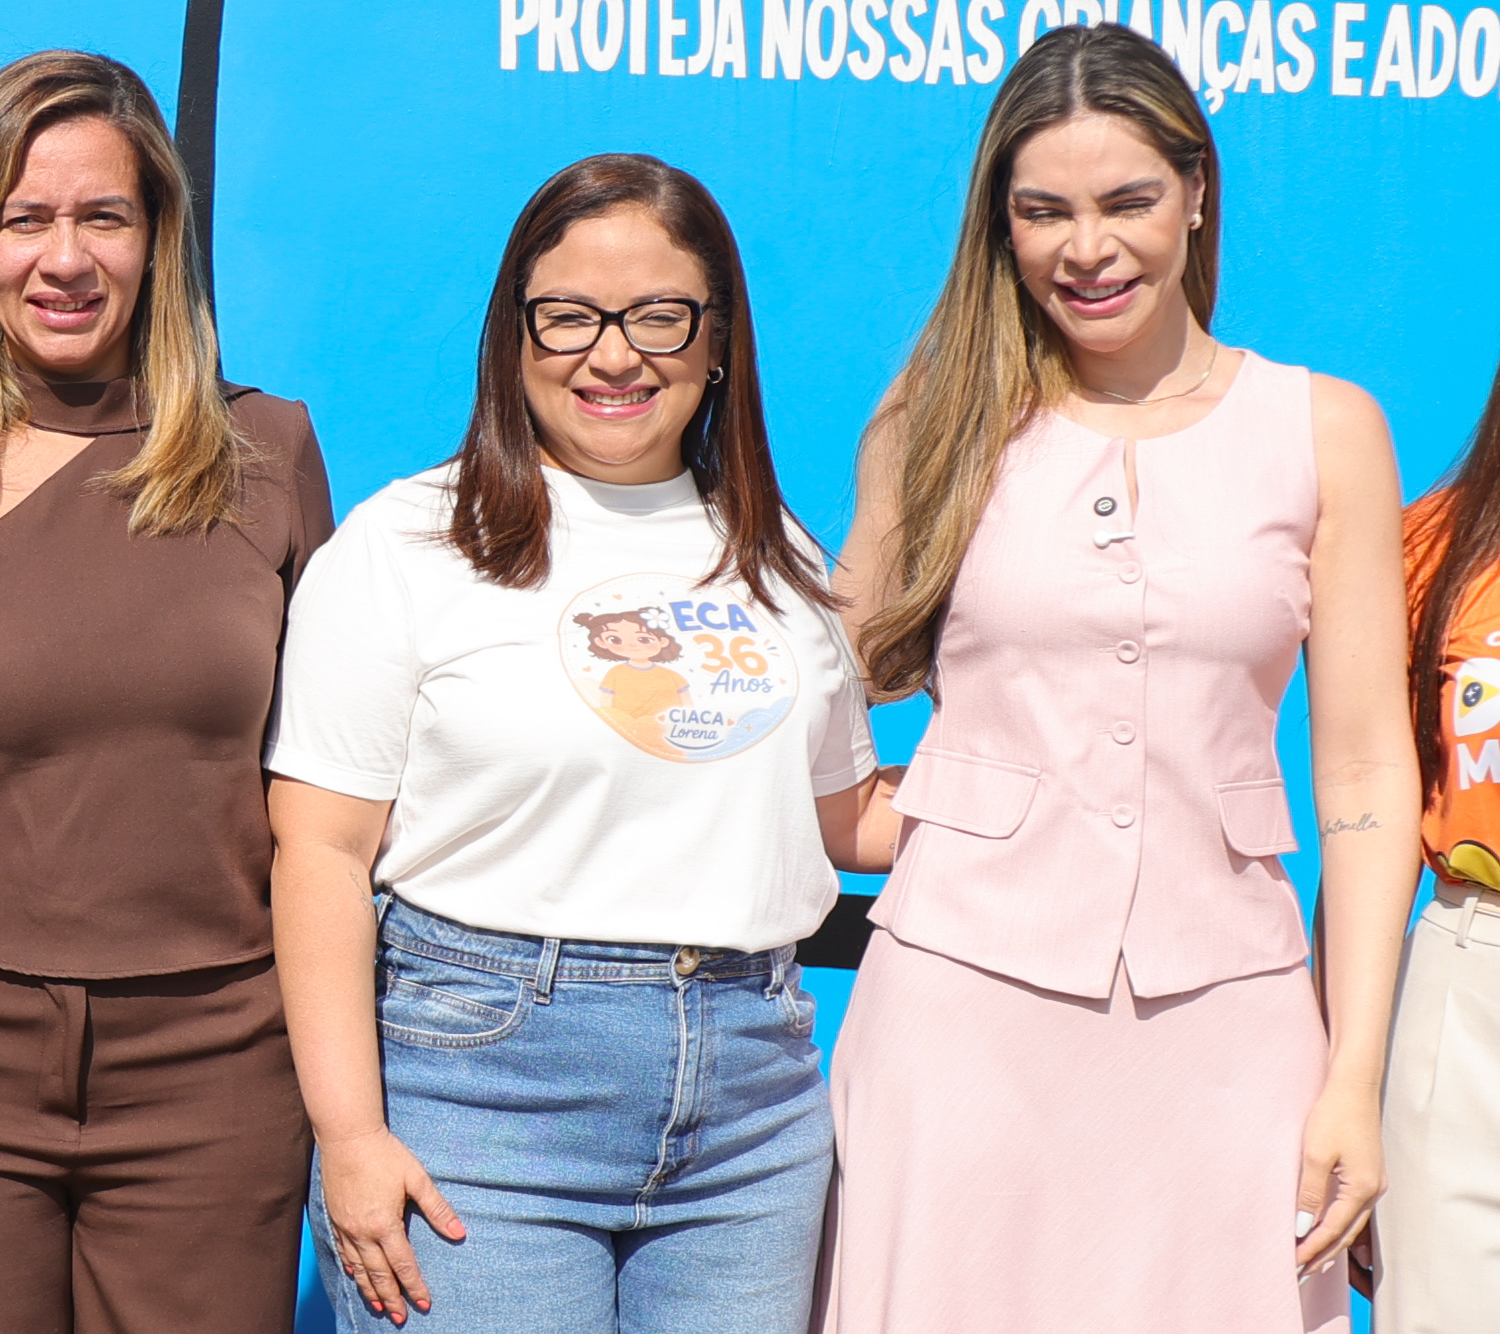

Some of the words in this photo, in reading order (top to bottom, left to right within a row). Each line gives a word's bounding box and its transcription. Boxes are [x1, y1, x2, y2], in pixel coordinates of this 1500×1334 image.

[668, 600, 758, 633] ECA
[692, 633, 769, 677] 36
[710, 669, 774, 696] Anos
[669, 709, 724, 726] CIACA
[670, 724, 719, 741] Lorena
